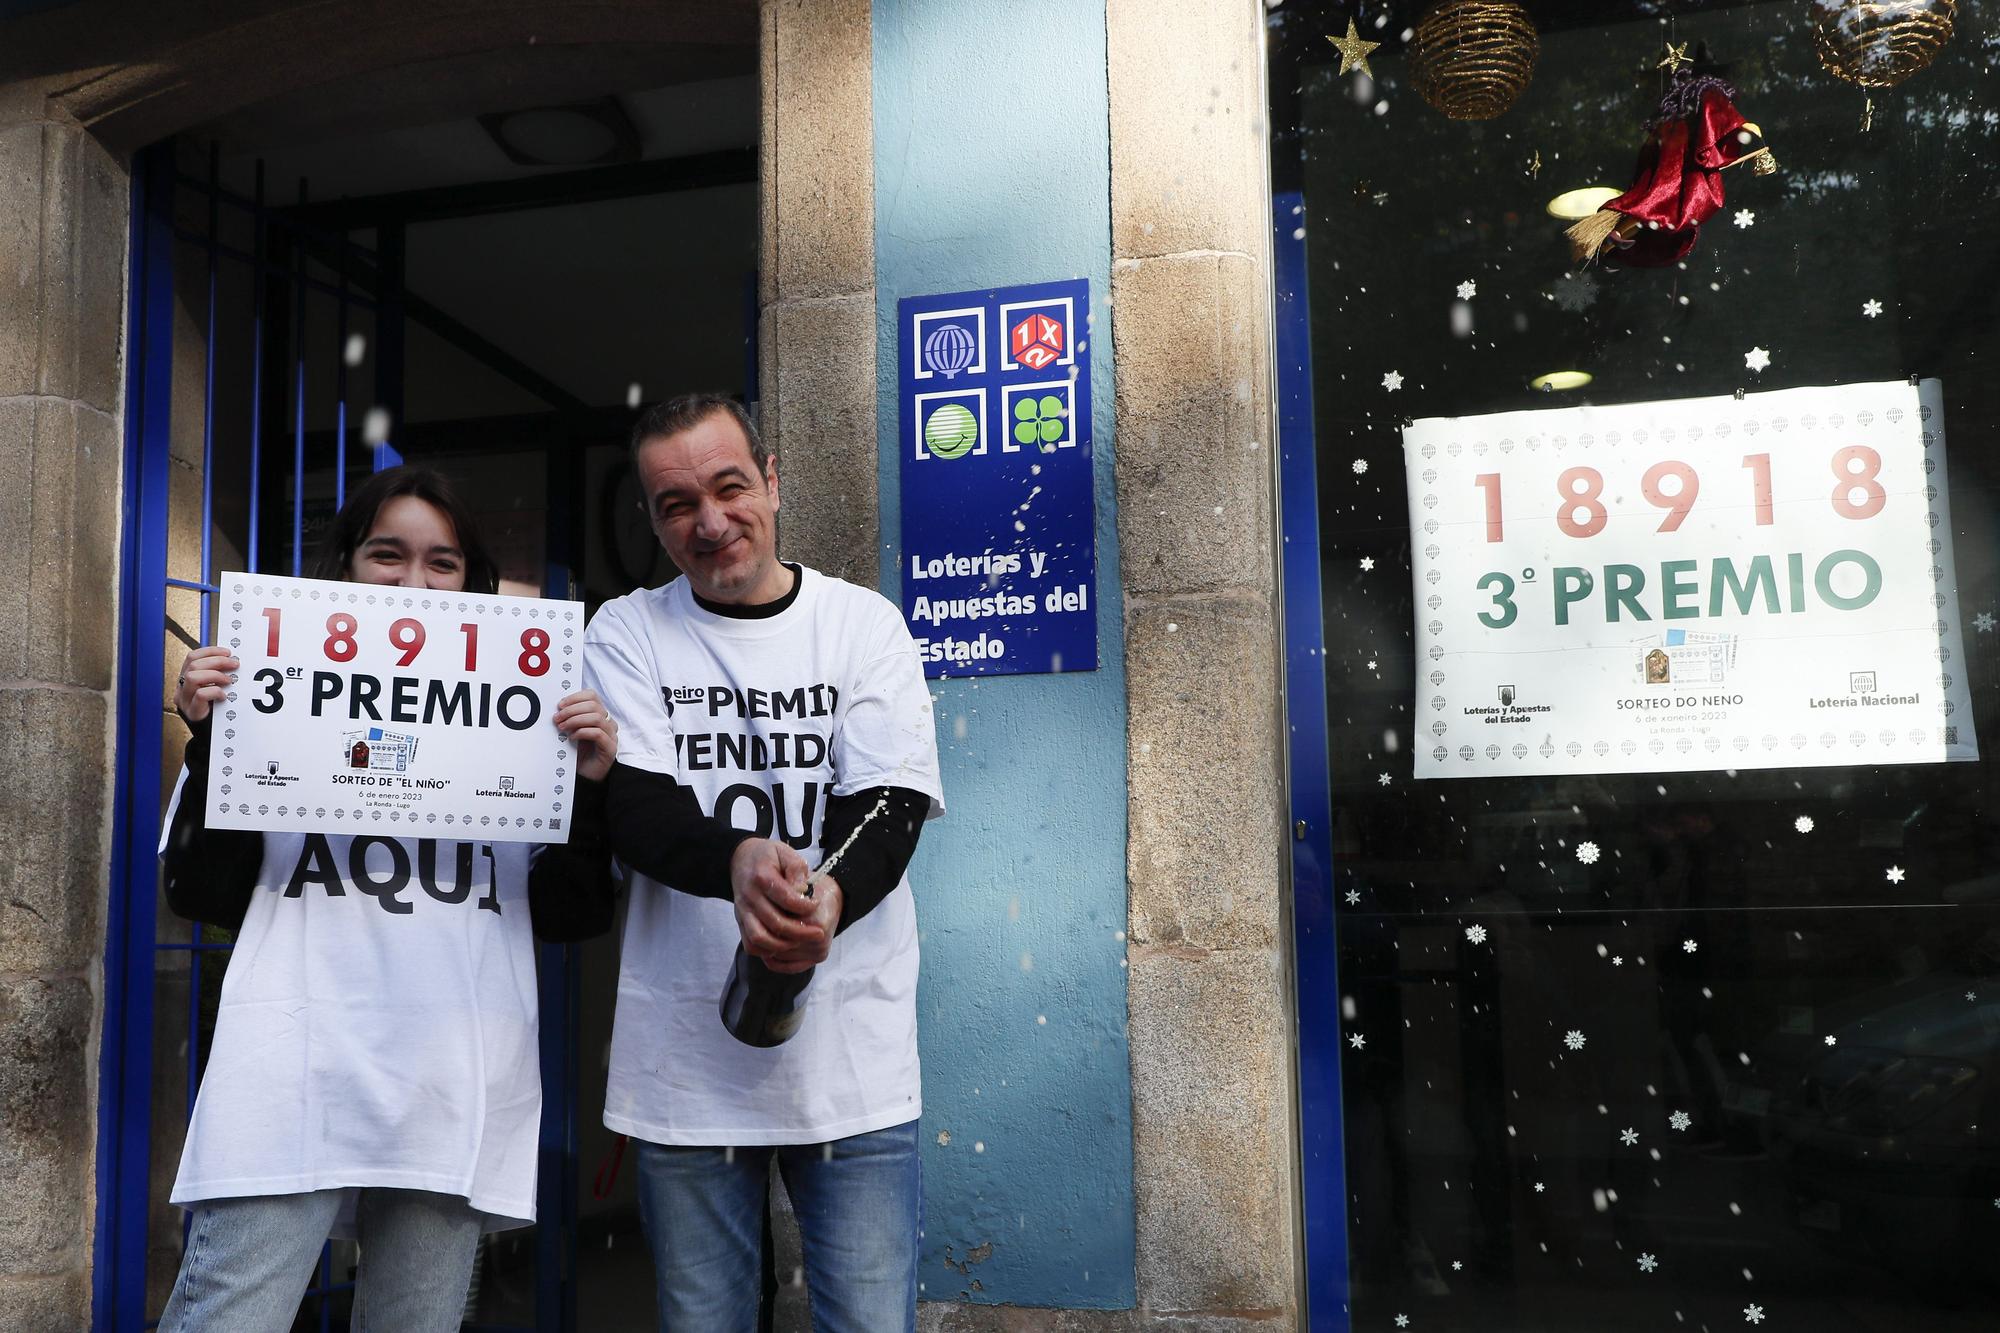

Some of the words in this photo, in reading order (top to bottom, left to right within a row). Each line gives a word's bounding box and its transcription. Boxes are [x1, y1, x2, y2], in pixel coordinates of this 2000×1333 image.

[1017, 322, 1029, 347] 1
[1041, 318, 1058, 347] X
[1025, 347, 1055, 367] 2
[912, 548, 1022, 579] Loterías
[1030, 552, 1046, 578] y
[1552, 549, 1883, 626] PREMIO
[912, 591, 1036, 627] Apuestas
[1045, 584, 1087, 613] del
[913, 633, 1005, 662] Estado
[311, 670, 541, 731] PREMIO
[1616, 698, 1671, 710] SORTEO
[1676, 697, 1697, 708] DO
[1702, 694, 1744, 706] NENO
[1810, 696, 1858, 708] Lotería
[1861, 693, 1920, 707] Nacional
[1464, 706, 1500, 715] Loterías
[1510, 705, 1551, 715] Apuestas
[1645, 715, 1657, 723] de
[1701, 712, 1727, 721] 2023
[1484, 716, 1498, 724] del
[1500, 715, 1531, 724] Estado
[675, 732, 835, 771] ENDID
[332, 775, 375, 786] SORTEO
[379, 778, 392, 787] DE
[416, 779, 451, 790] NIÑO"
[402, 793, 422, 801] 2023
[476, 789, 502, 797] Lotería
[504, 791, 535, 799] Nacional
